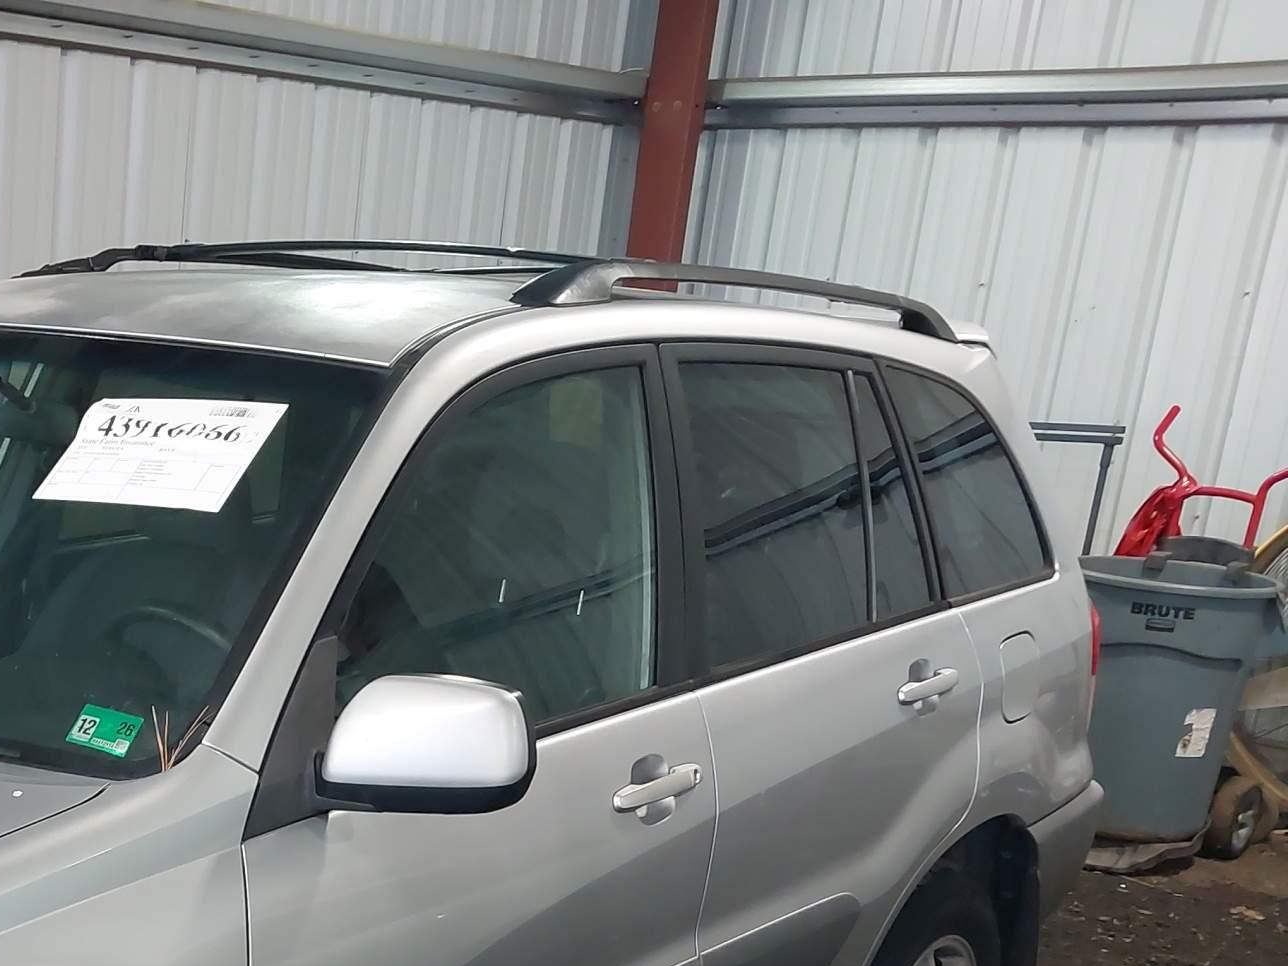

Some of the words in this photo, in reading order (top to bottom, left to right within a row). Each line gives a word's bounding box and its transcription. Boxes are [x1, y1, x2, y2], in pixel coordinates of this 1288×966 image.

[1130, 601, 1195, 620] BRUTE
[77, 718, 97, 735] 12
[116, 721, 135, 737] 26
